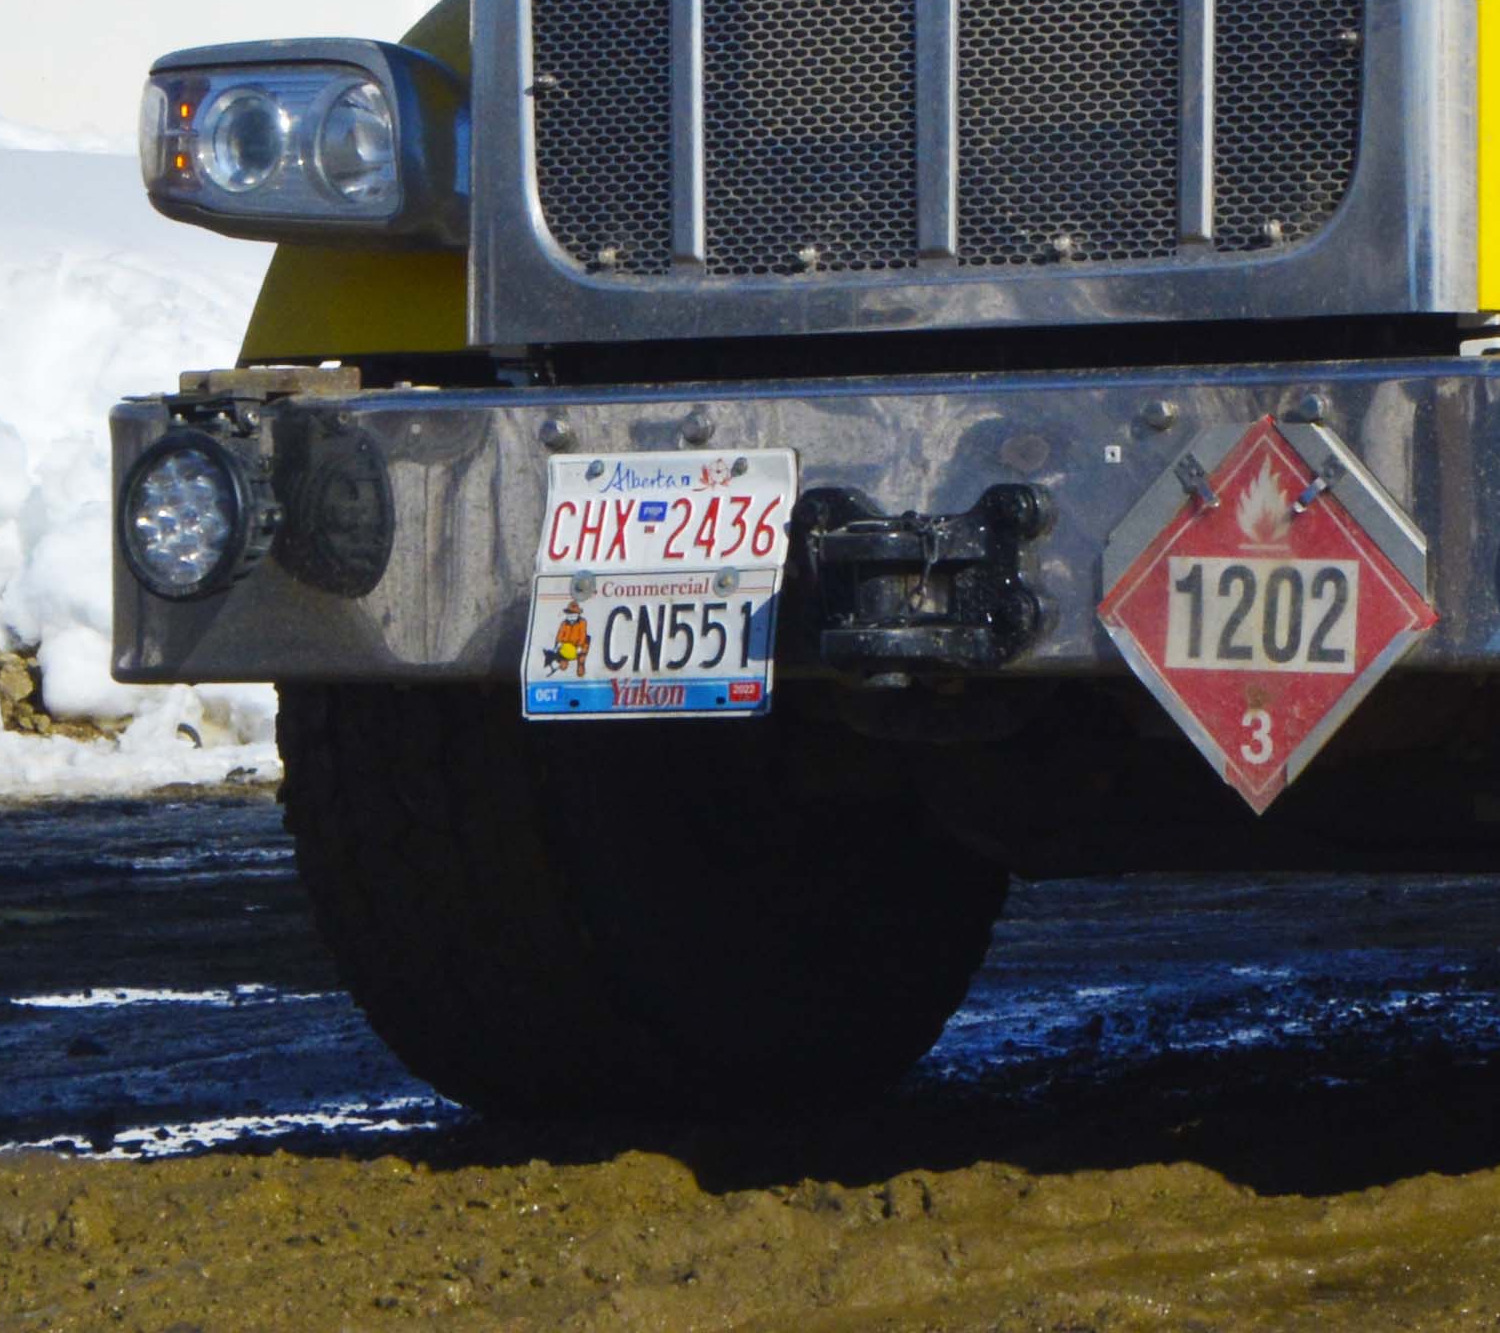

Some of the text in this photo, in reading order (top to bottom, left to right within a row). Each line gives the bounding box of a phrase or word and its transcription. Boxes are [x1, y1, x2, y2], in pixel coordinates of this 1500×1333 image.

[600, 460, 677, 493] Alberta
[602, 580, 711, 599] Commercial
[1175, 563, 1348, 664] 1202
[602, 601, 754, 672] CN551
[536, 688, 559, 703] OCT
[610, 678, 686, 709] Yukon
[1240, 709, 1274, 765] 3
